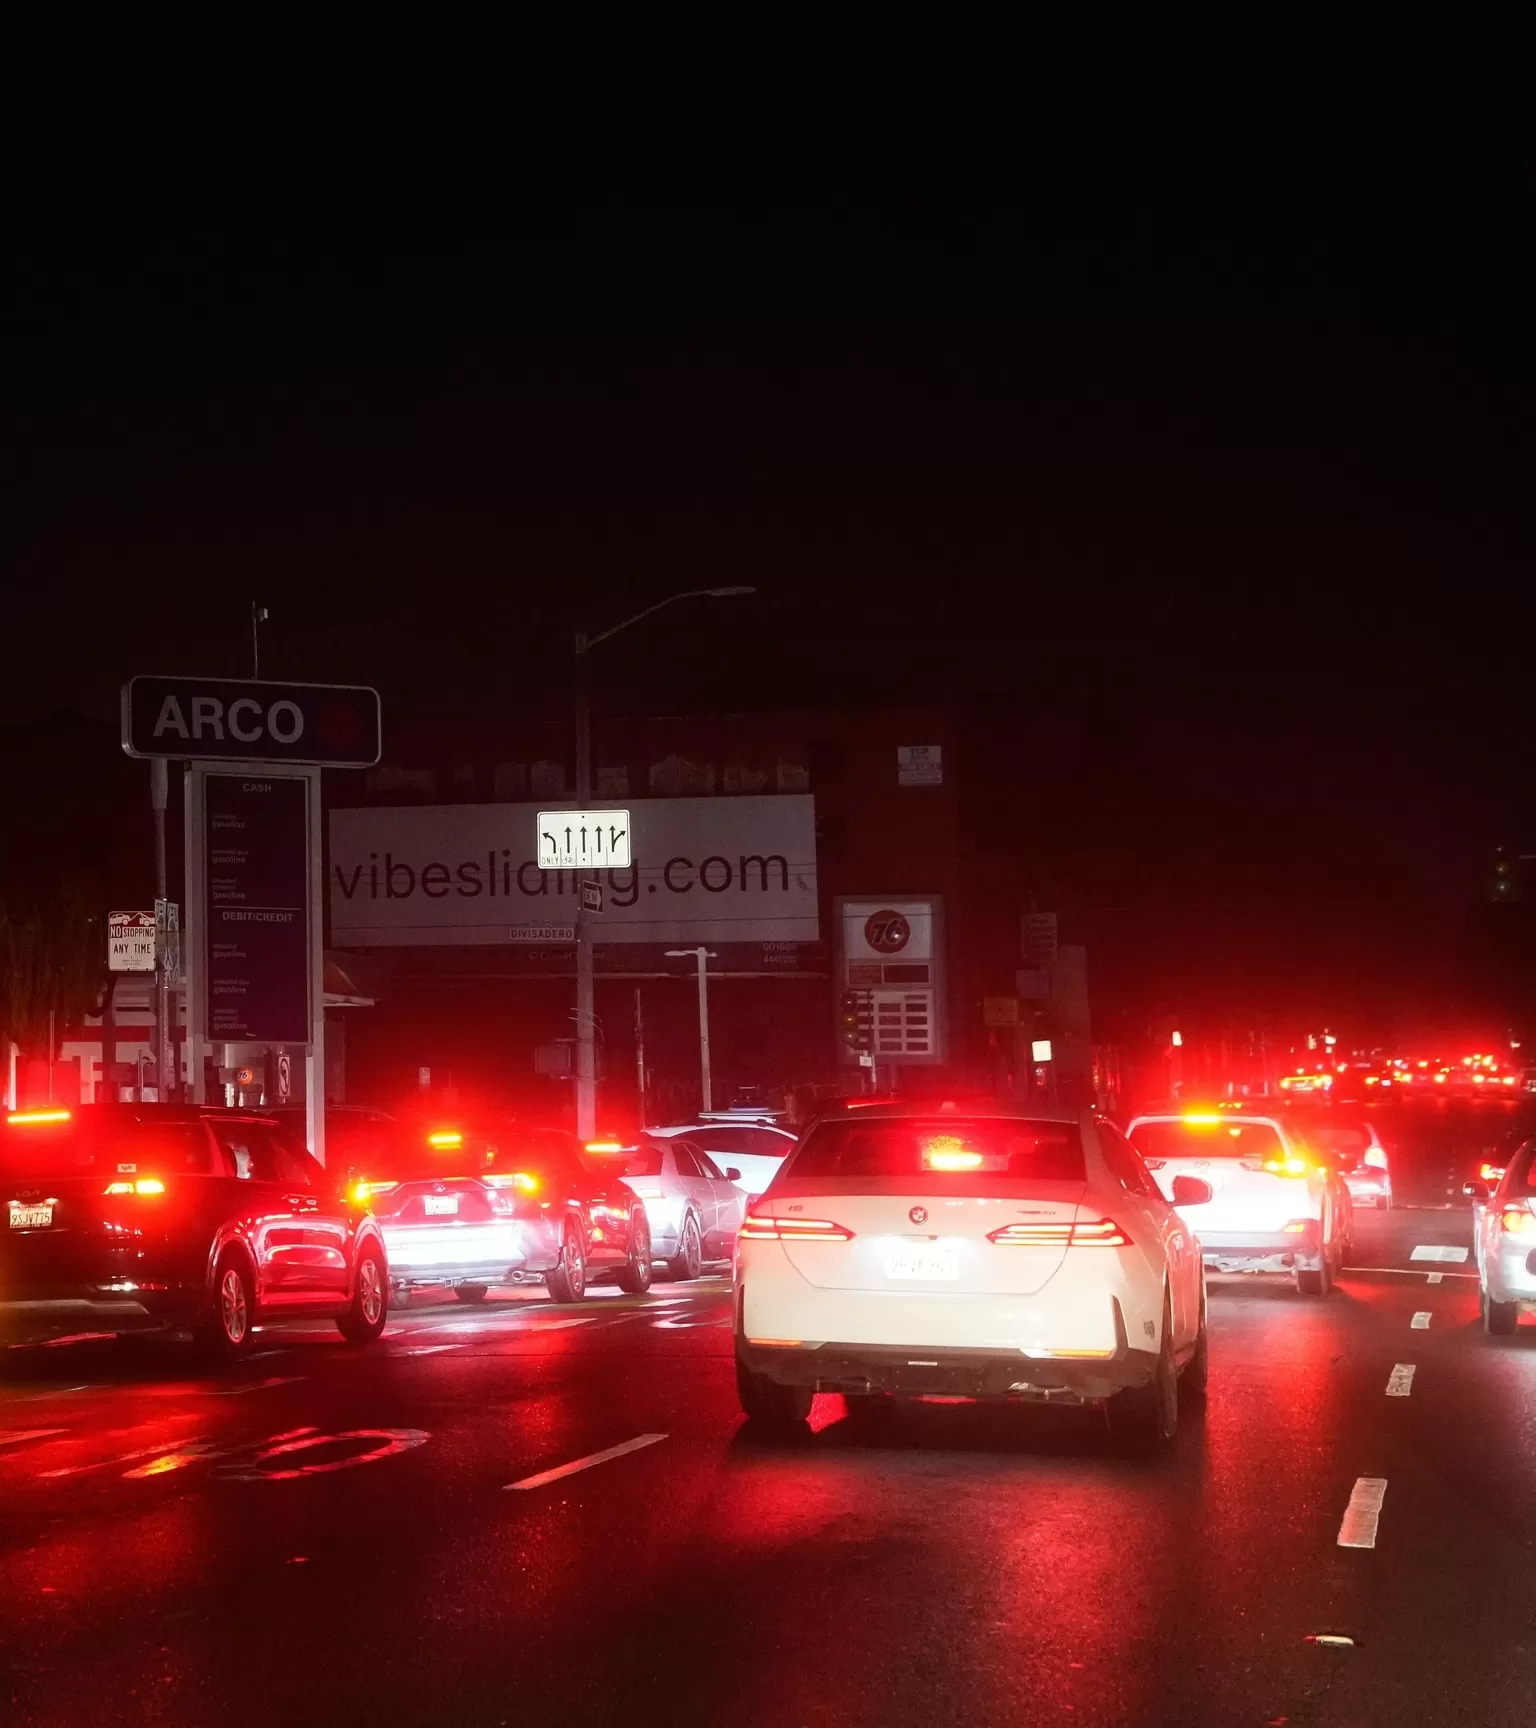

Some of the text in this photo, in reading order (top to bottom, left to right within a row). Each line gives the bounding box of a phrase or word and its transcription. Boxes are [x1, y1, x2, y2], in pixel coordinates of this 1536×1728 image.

[153, 695, 304, 744] ARCO
[242, 783, 272, 793] CASH
[541, 856, 559, 866] ONLY
[222, 911, 294, 922] DEBIT/CREDIT
[110, 925, 154, 938] NO STOPPING
[511, 929, 572, 939] DIVISADERO
[871, 918, 904, 945] 76
[114, 943, 151, 954] ANY TIME
